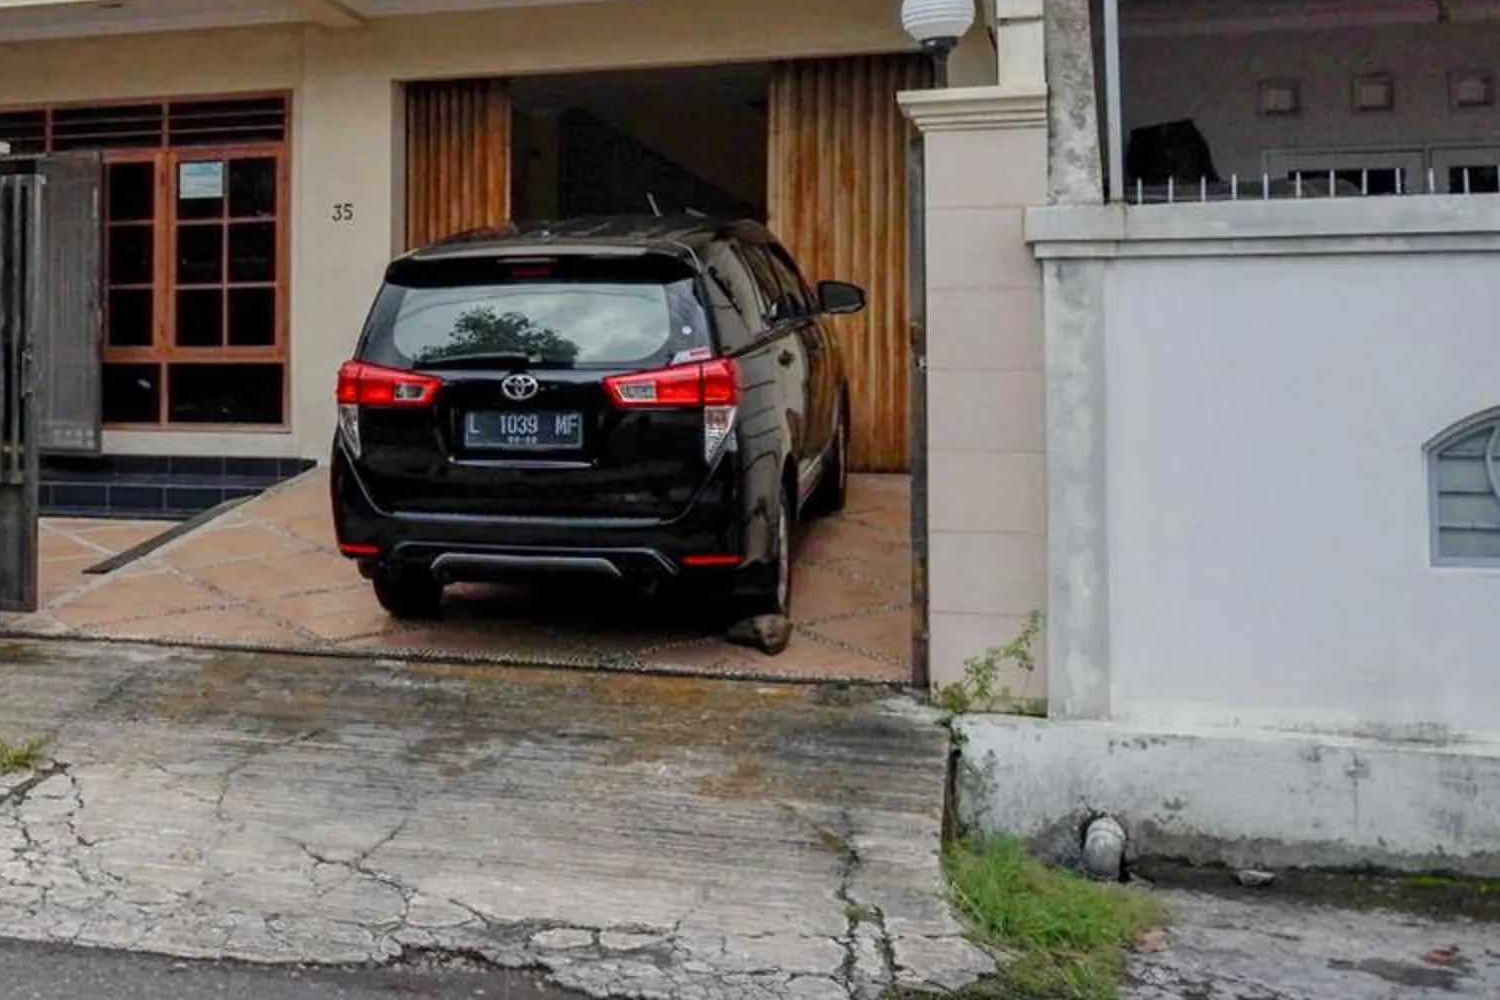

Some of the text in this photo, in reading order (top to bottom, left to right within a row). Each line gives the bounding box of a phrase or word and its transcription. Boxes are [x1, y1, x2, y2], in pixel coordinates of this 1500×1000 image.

[331, 203, 353, 221] 35
[468, 412, 579, 435] L 1039 MF
